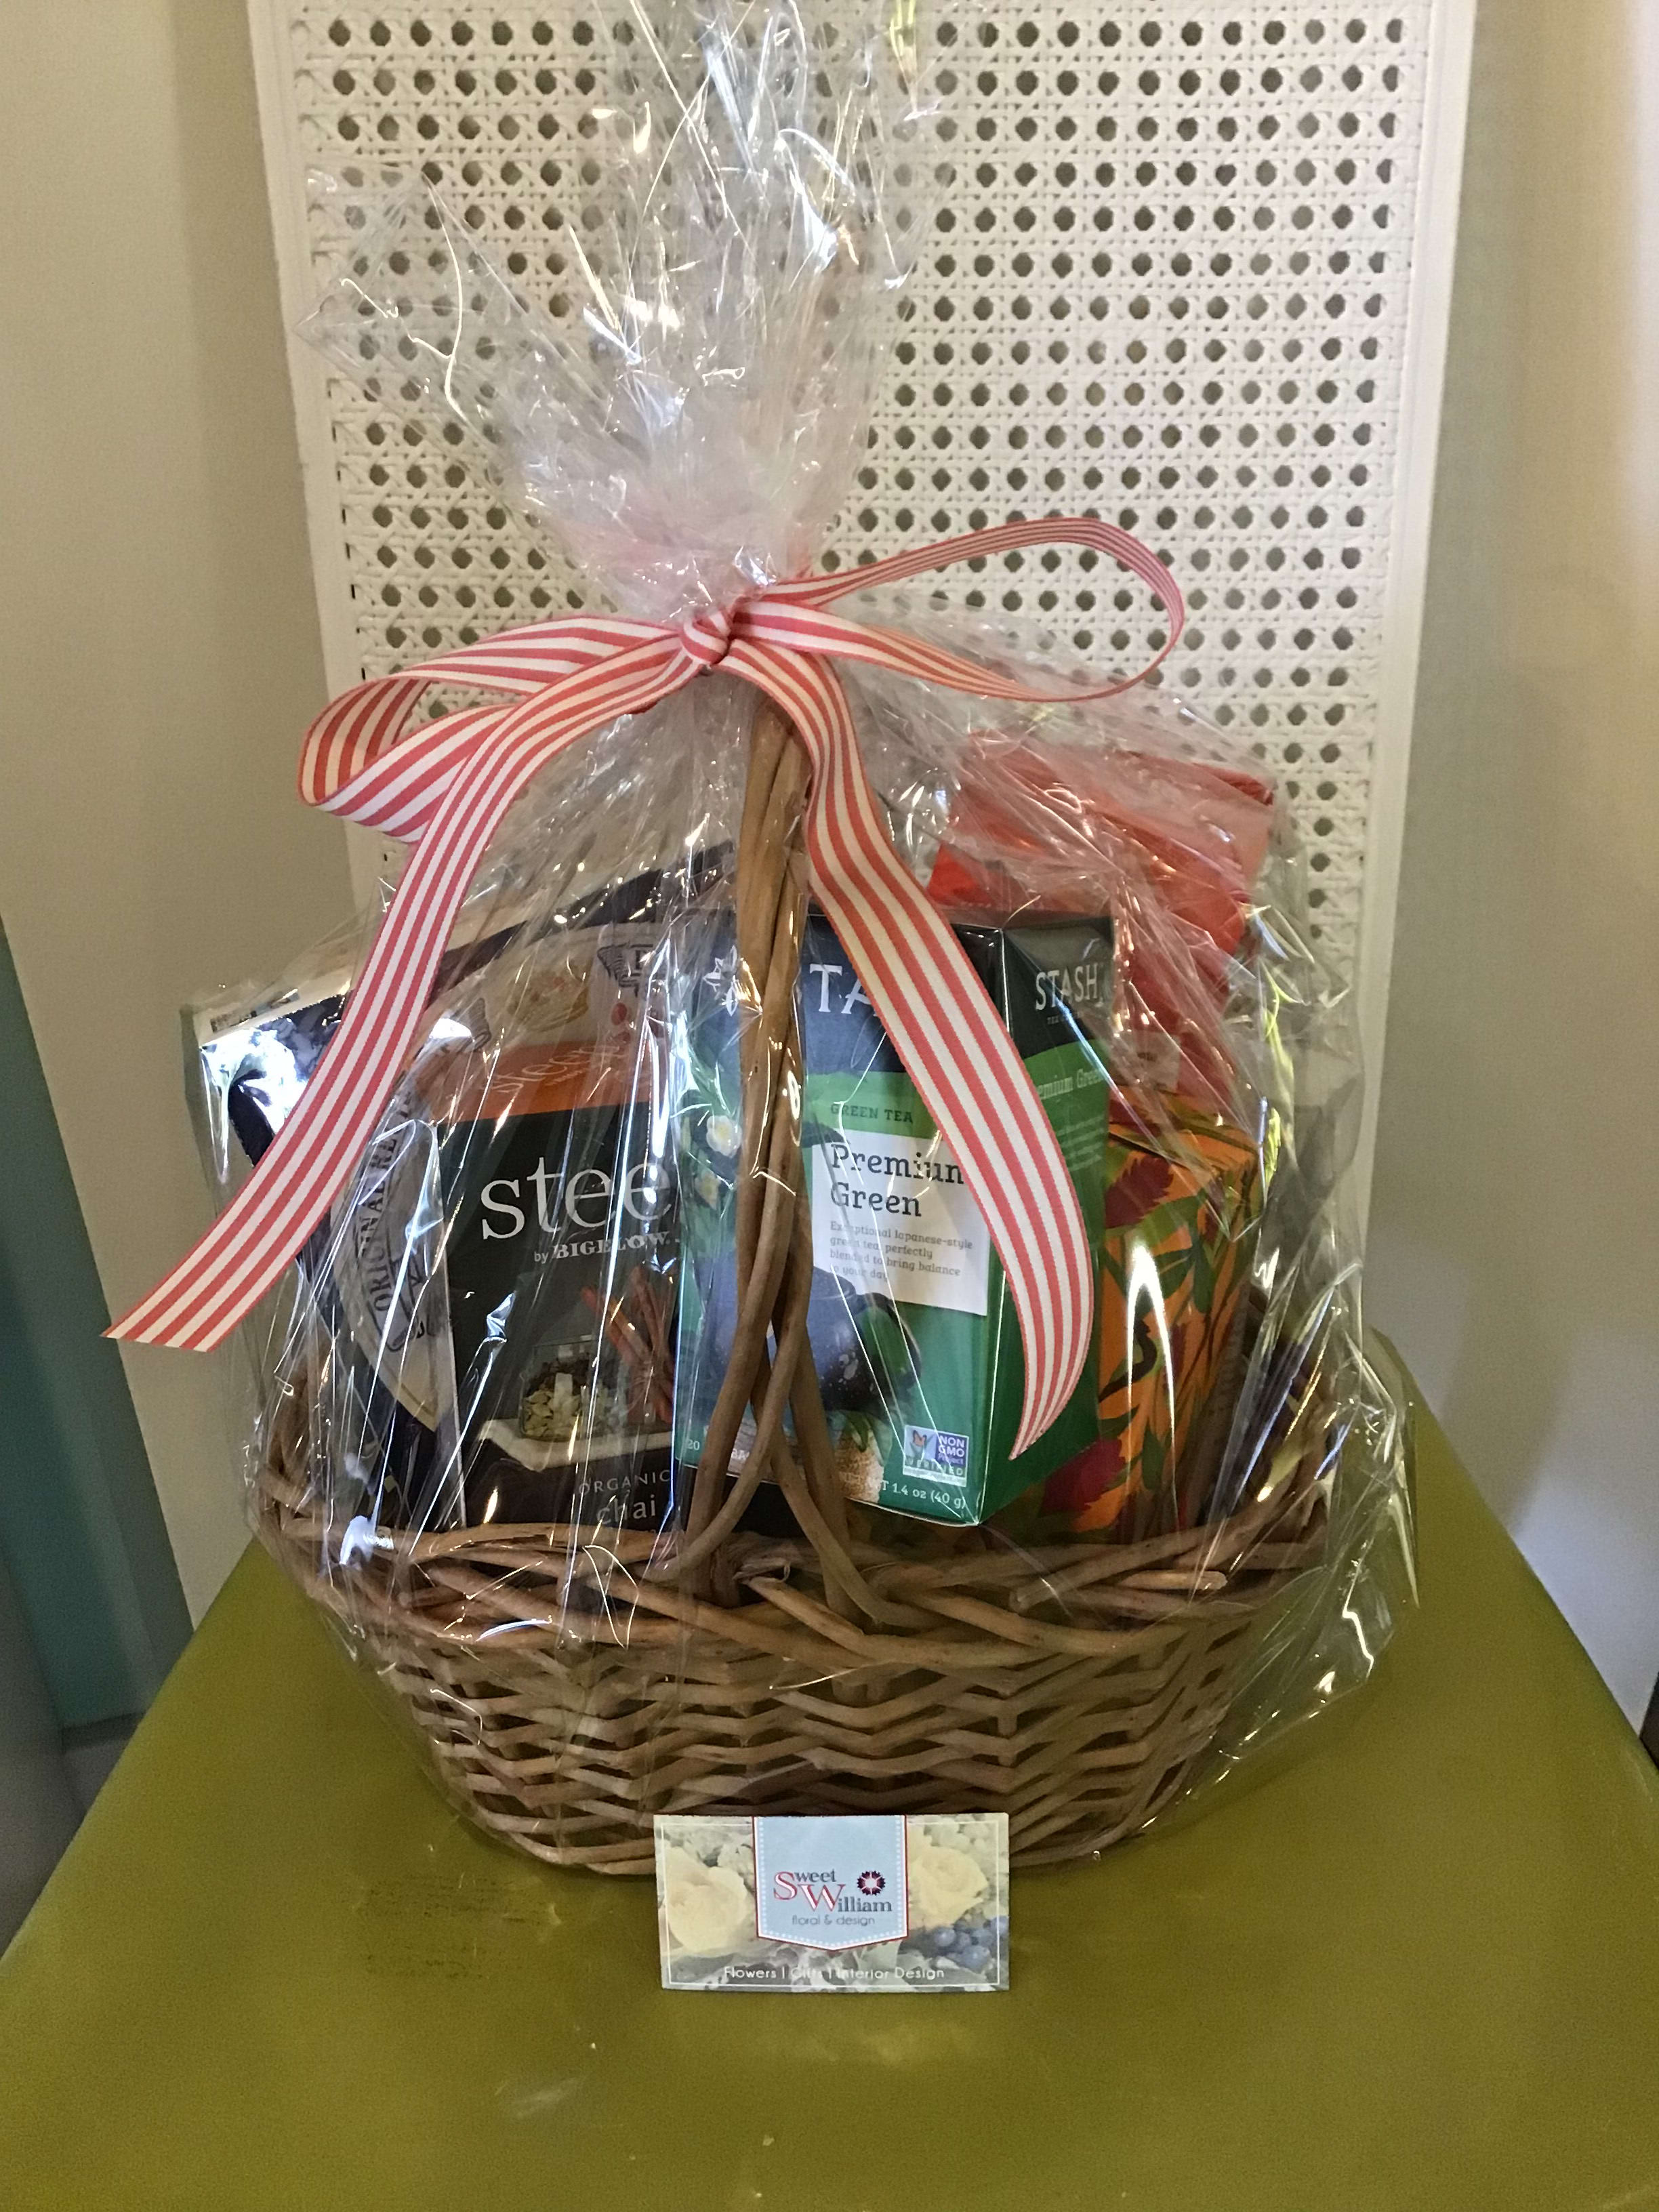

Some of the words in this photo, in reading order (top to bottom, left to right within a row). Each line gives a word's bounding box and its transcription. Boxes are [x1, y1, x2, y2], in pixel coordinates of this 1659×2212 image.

[1036, 963, 1098, 1010] STASH
[831, 1104, 878, 1119] GREEN
[884, 1109, 914, 1124] TEA
[480, 1156, 672, 1241] stee
[830, 1181, 922, 1217] Green
[534, 1250, 549, 1265] by
[885, 1244, 933, 1260] perfectly
[886, 1256, 916, 1272] bring
[918, 1261, 962, 1277] balance
[687, 1439, 700, 1451] 20
[939, 1435, 966, 1448] NON
[938, 1446, 966, 1458] GMO
[579, 1469, 672, 1495] ORGANIC
[913, 1489, 926, 1499] oz
[596, 1494, 657, 1525] chai
[773, 1868, 837, 1901] Sweet
[797, 1883, 893, 1912] William
[792, 1914, 821, 1926] floral
[823, 1914, 832, 1926] &
[836, 1914, 876, 1927] design
[723, 1966, 777, 1979] Flowers
[895, 1966, 945, 1980] Design
